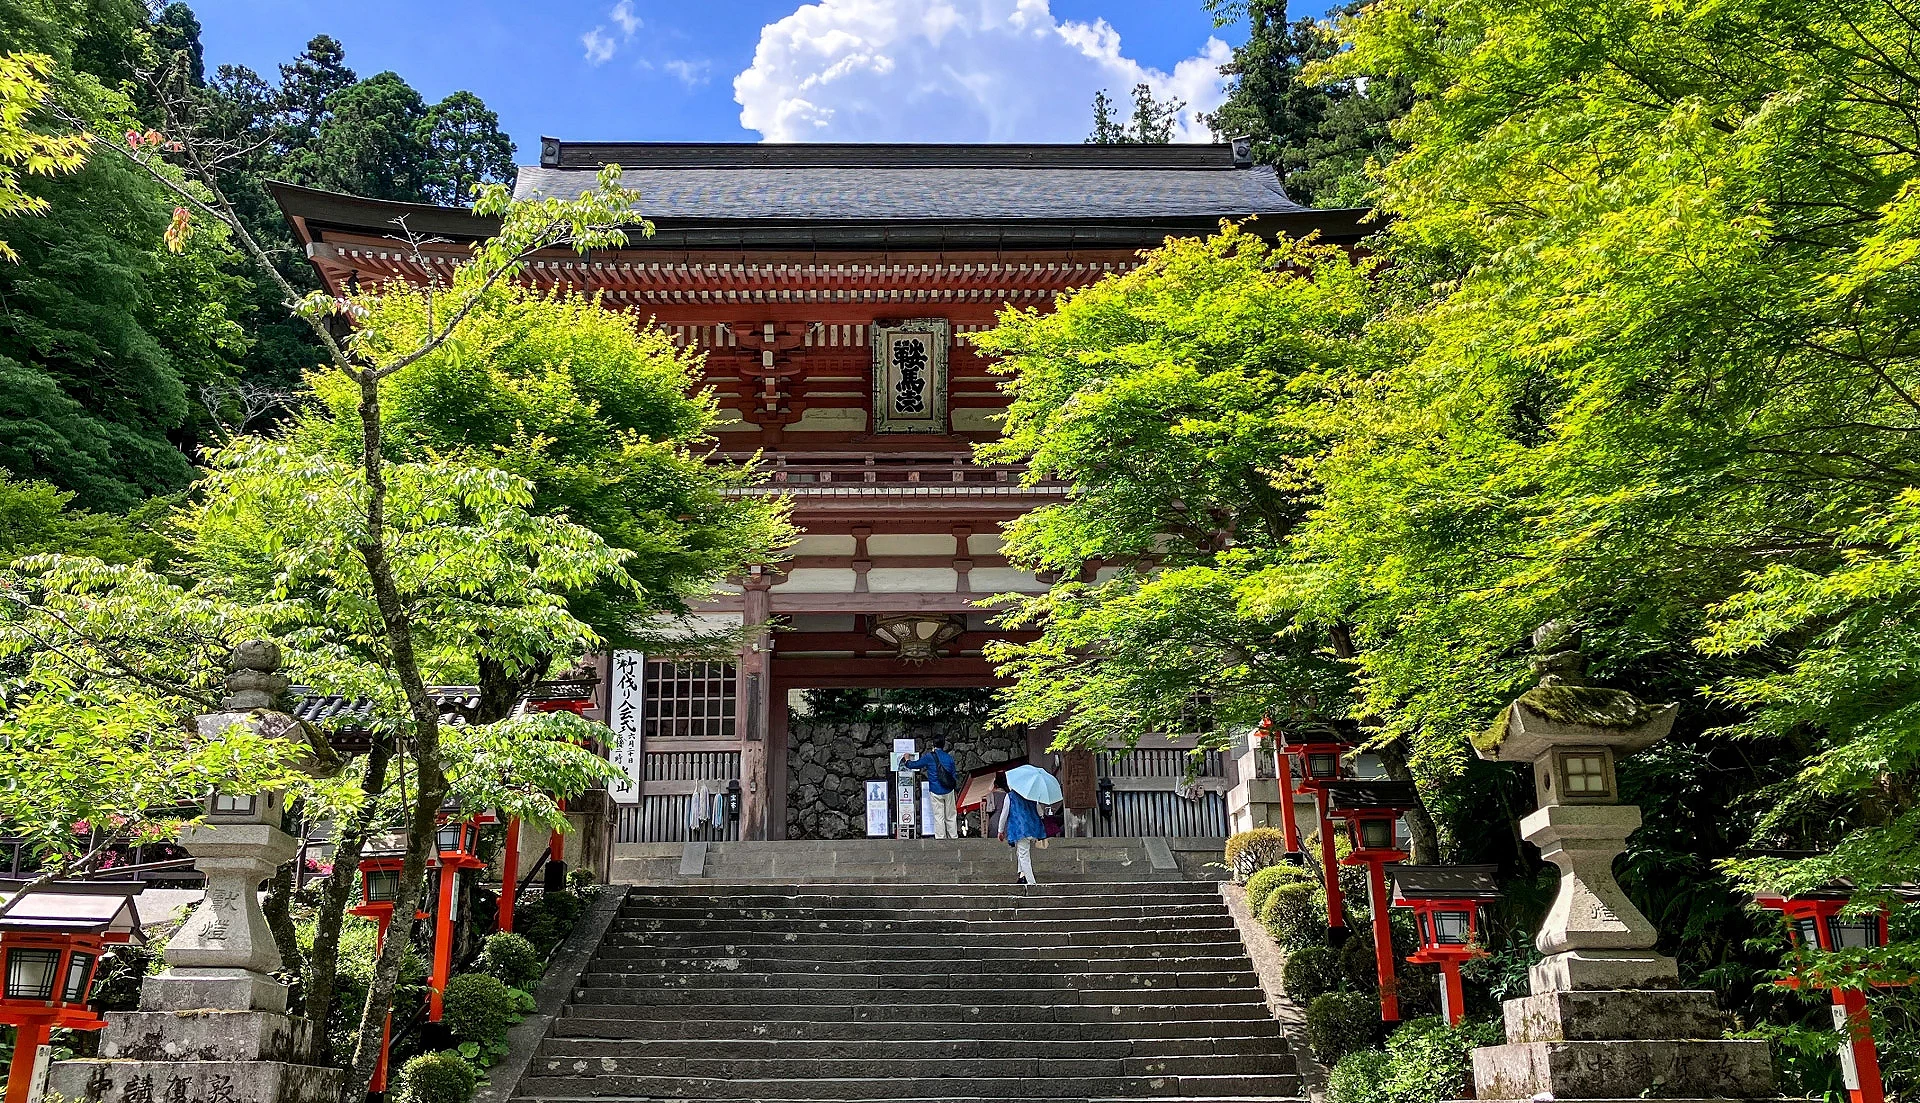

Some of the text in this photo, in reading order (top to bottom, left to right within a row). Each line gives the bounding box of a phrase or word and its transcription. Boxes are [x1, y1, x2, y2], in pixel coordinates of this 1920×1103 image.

[892, 338, 928, 413] 鞍馬寺
[617, 656, 638, 733] 竹伐り会式
